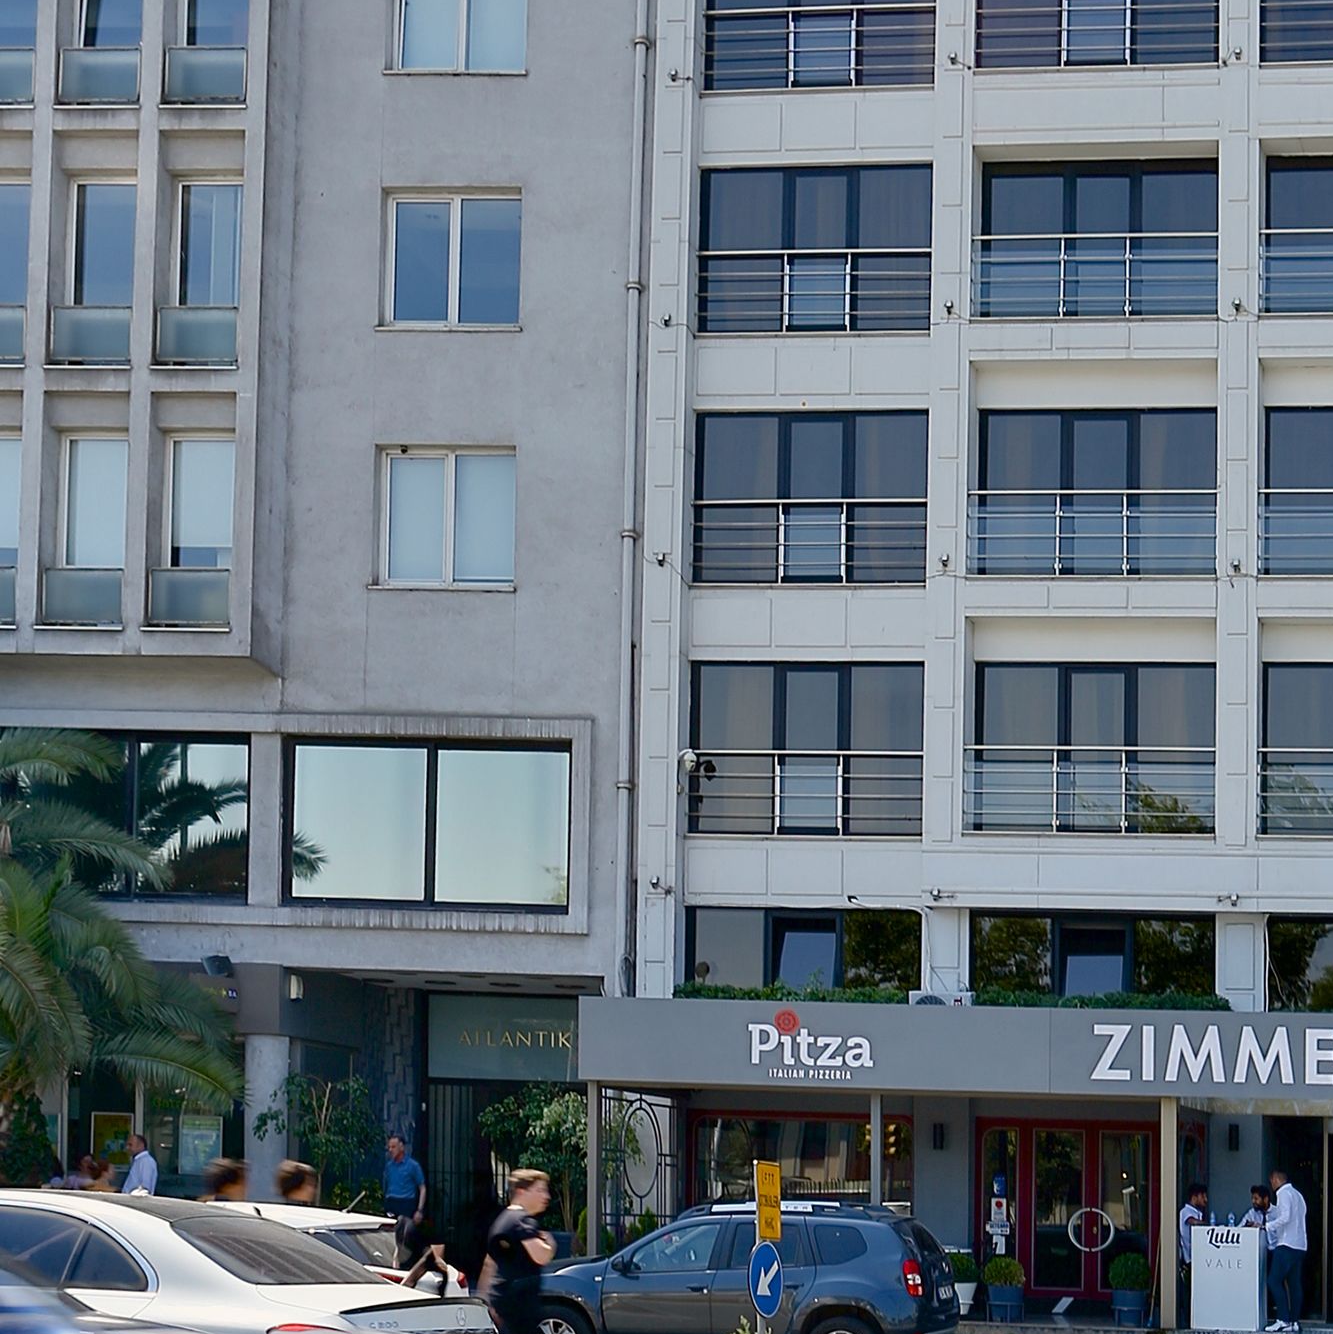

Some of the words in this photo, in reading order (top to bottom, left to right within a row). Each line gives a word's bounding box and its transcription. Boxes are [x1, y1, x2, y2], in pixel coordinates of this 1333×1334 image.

[747, 1009, 874, 1068] Pitza
[768, 1068, 805, 1079] ITALIAN
[808, 1069, 852, 1080] PIZZERIA
[1206, 1227, 1241, 1249] Lulu
[1205, 1258, 1243, 1269] VALE
